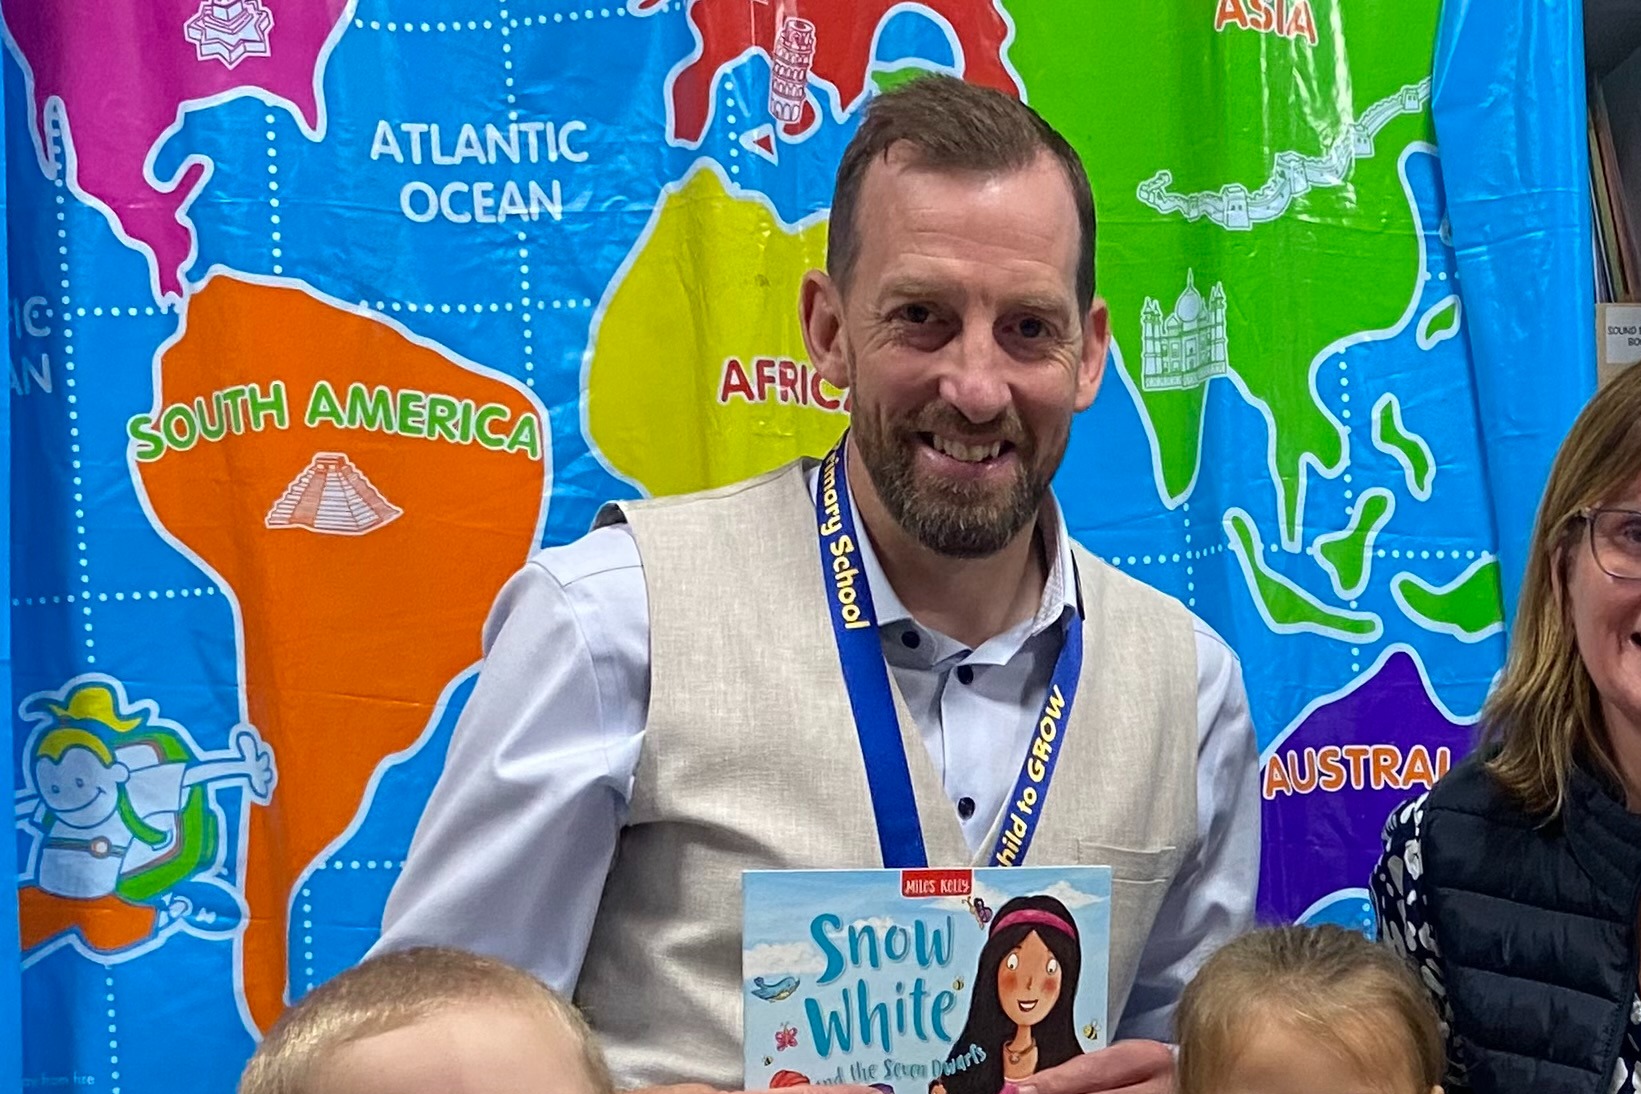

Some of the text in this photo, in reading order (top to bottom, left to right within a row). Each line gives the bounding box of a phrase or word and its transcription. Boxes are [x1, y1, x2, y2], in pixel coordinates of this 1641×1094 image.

[1215, 0, 1319, 46] ASIA
[370, 120, 590, 165] ATLANTIC
[400, 181, 564, 224] OCEAN
[1607, 326, 1637, 335] SOUND
[719, 356, 851, 413] AFRIC
[127, 380, 542, 461] SOUTH AMERICA
[830, 535, 870, 630] School
[996, 685, 1066, 867] hild to GROW
[809, 913, 954, 985] Snow
[804, 977, 957, 1060] White
[850, 1060, 878, 1081] the
[931, 1043, 988, 1077] Dwarfs
